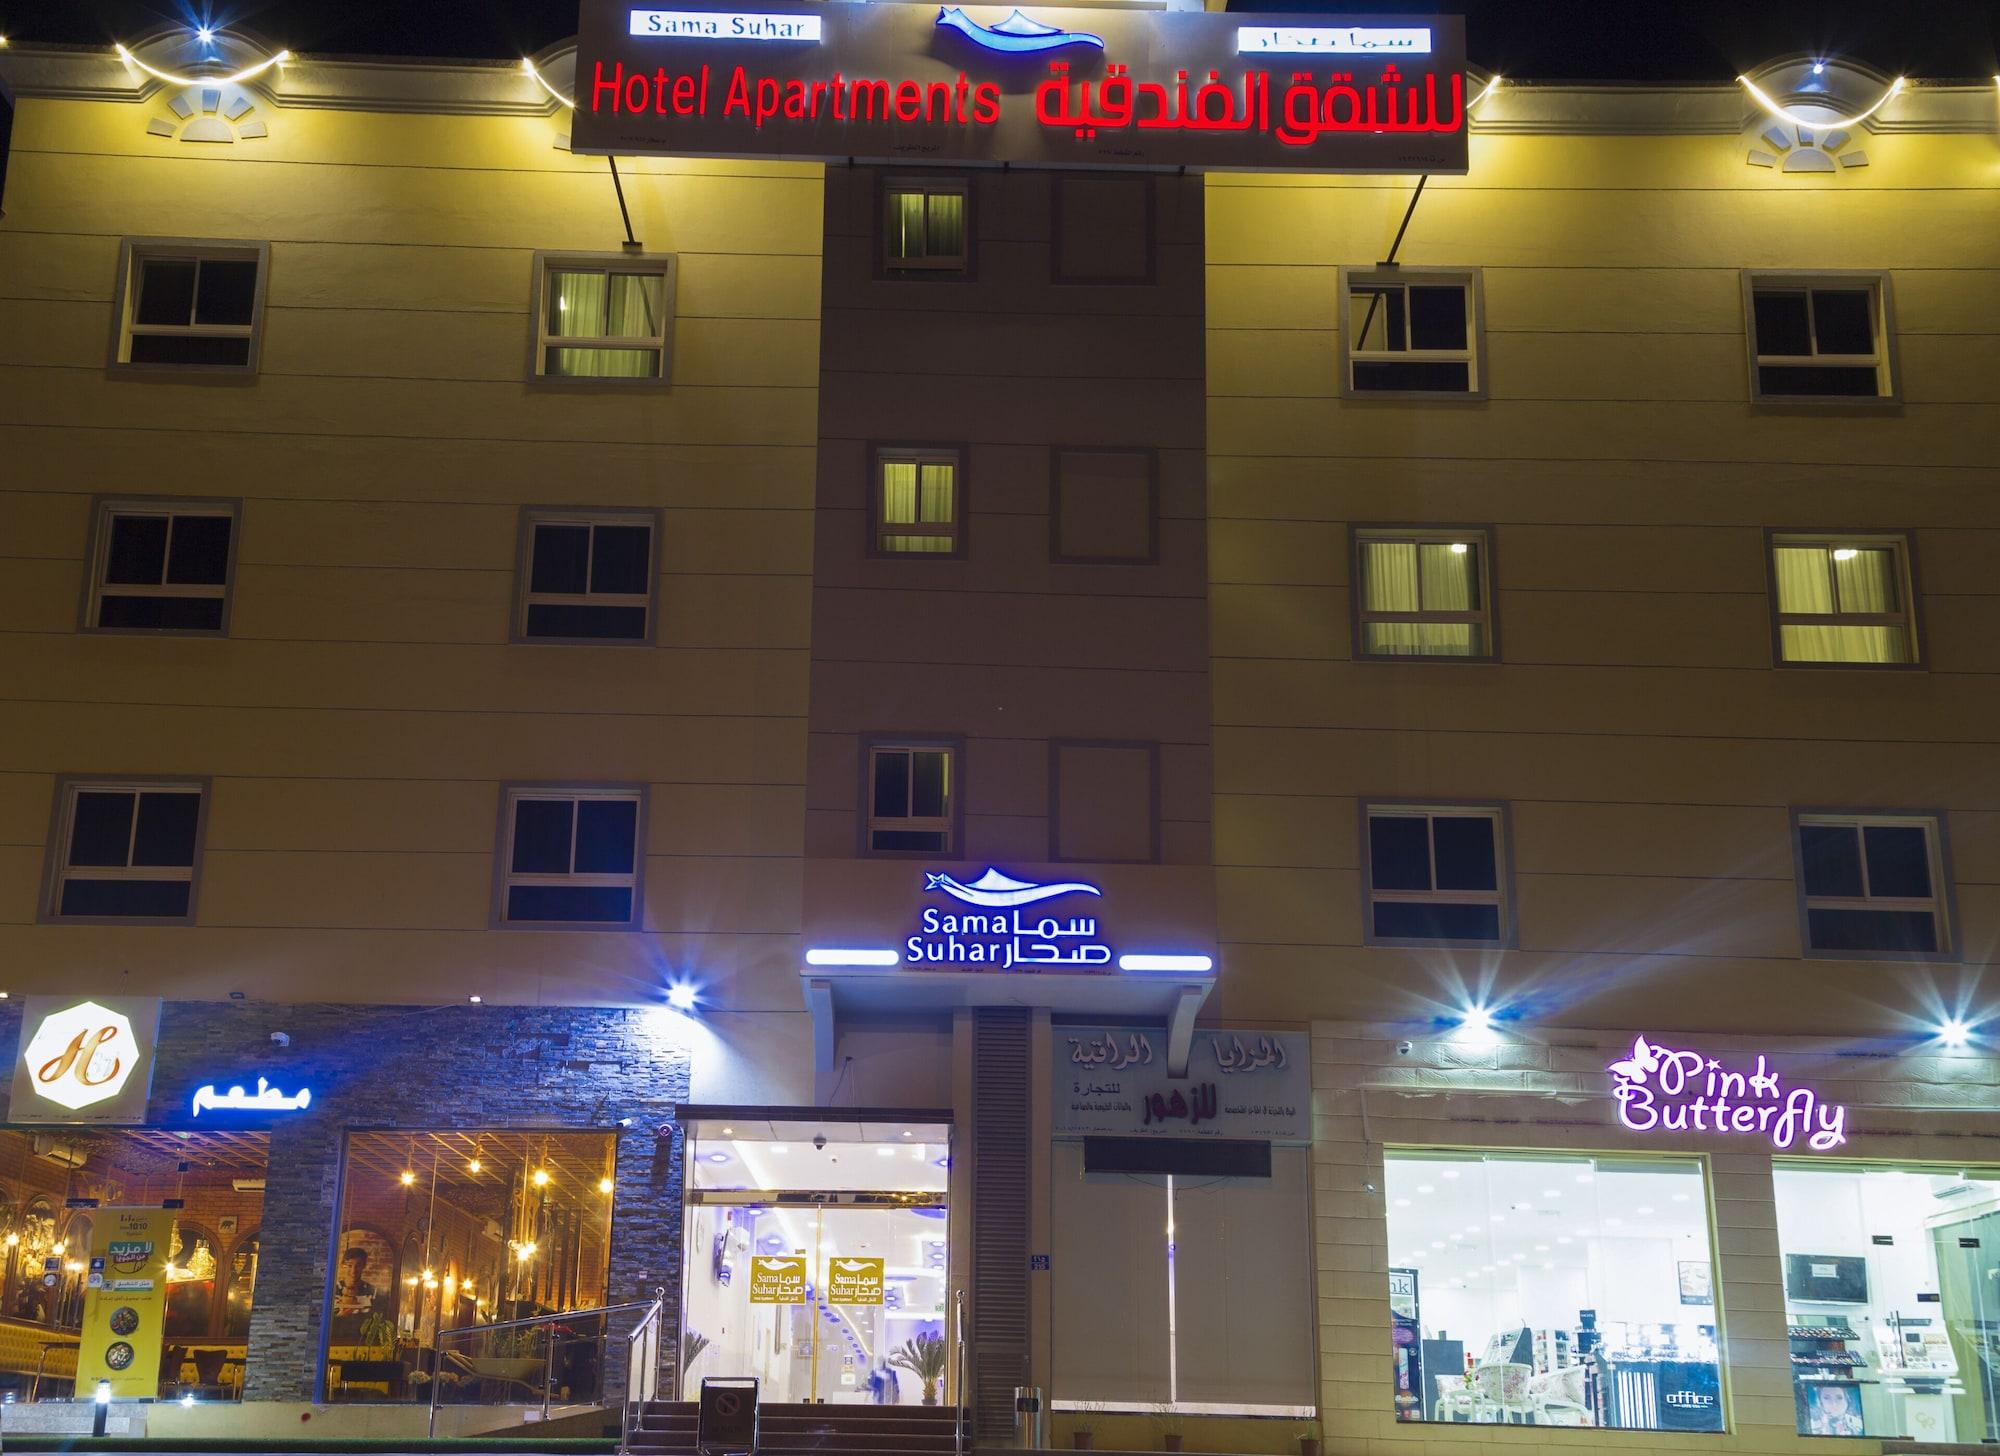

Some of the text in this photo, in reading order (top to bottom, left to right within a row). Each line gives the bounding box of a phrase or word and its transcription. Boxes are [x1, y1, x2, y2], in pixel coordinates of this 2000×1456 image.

[648, 15, 805, 38] Sama Suhar
[591, 60, 1000, 128] Hotel Apartments
[1035, 61, 1463, 145] للشقق الفندقية
[923, 908, 1008, 934] Sama
[1013, 909, 1095, 939] سما
[907, 935, 1000, 962] Suhar
[1002, 936, 1111, 968] صحار
[1067, 1031, 1288, 1074] المزايا الراقية
[1650, 1045, 1779, 1099] Pink
[193, 1076, 311, 1118] مطعم
[1073, 1082, 1121, 1097] للتجارة
[1144, 1082, 1217, 1125] للزهور
[1612, 1074, 1846, 1150] Butterfly
[110, 1243, 141, 1257] مزيد
[753, 1283, 777, 1295] Suhar
[757, 1272, 779, 1283] Sama
[779, 1273, 800, 1285] سما
[835, 1273, 857, 1284] Sama
[857, 1274, 878, 1286] سما
[776, 1284, 804, 1297] صحار
[831, 1284, 854, 1295] Suhar
[854, 1285, 881, 1297] صحار
[1666, 1390, 1714, 1405] office
